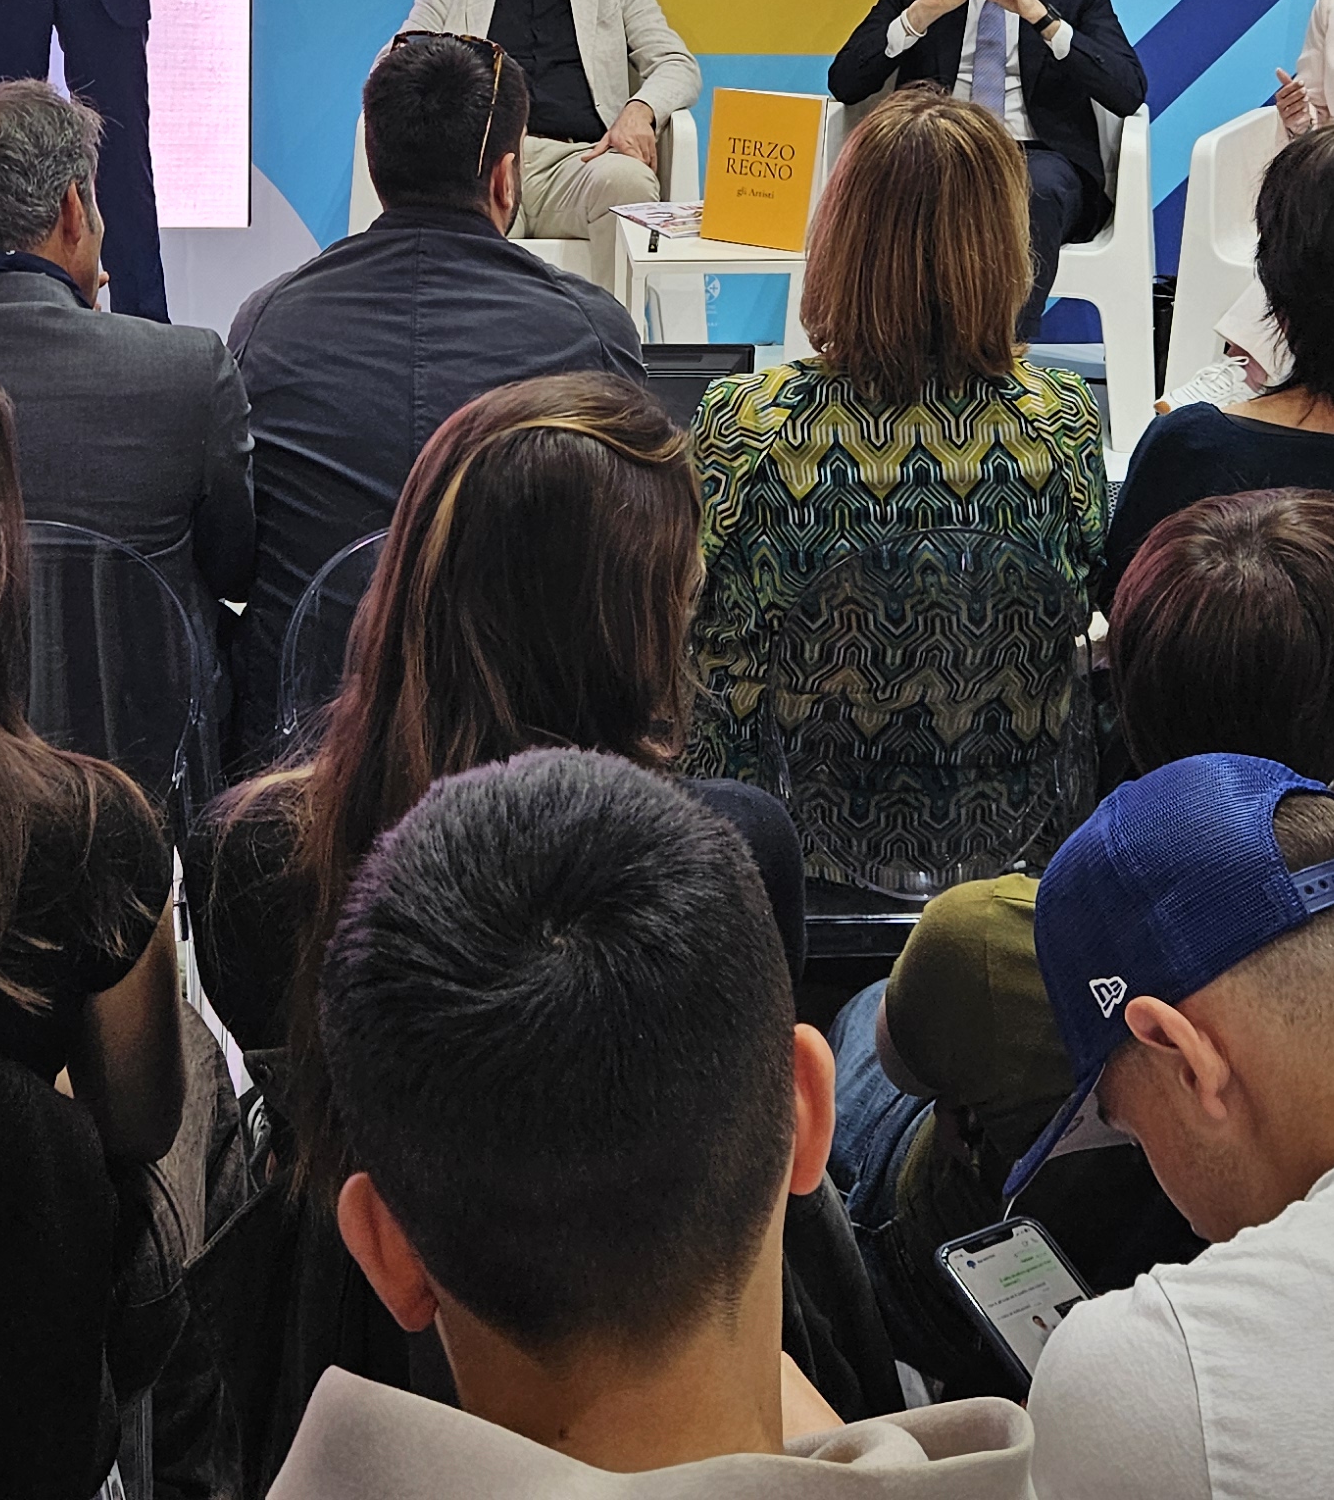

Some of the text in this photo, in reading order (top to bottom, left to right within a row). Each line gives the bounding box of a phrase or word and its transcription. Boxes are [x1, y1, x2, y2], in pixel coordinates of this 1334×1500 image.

[728, 137, 795, 162] TERZO
[726, 157, 793, 181] REGNO
[737, 187, 775, 199] gli Artisti
